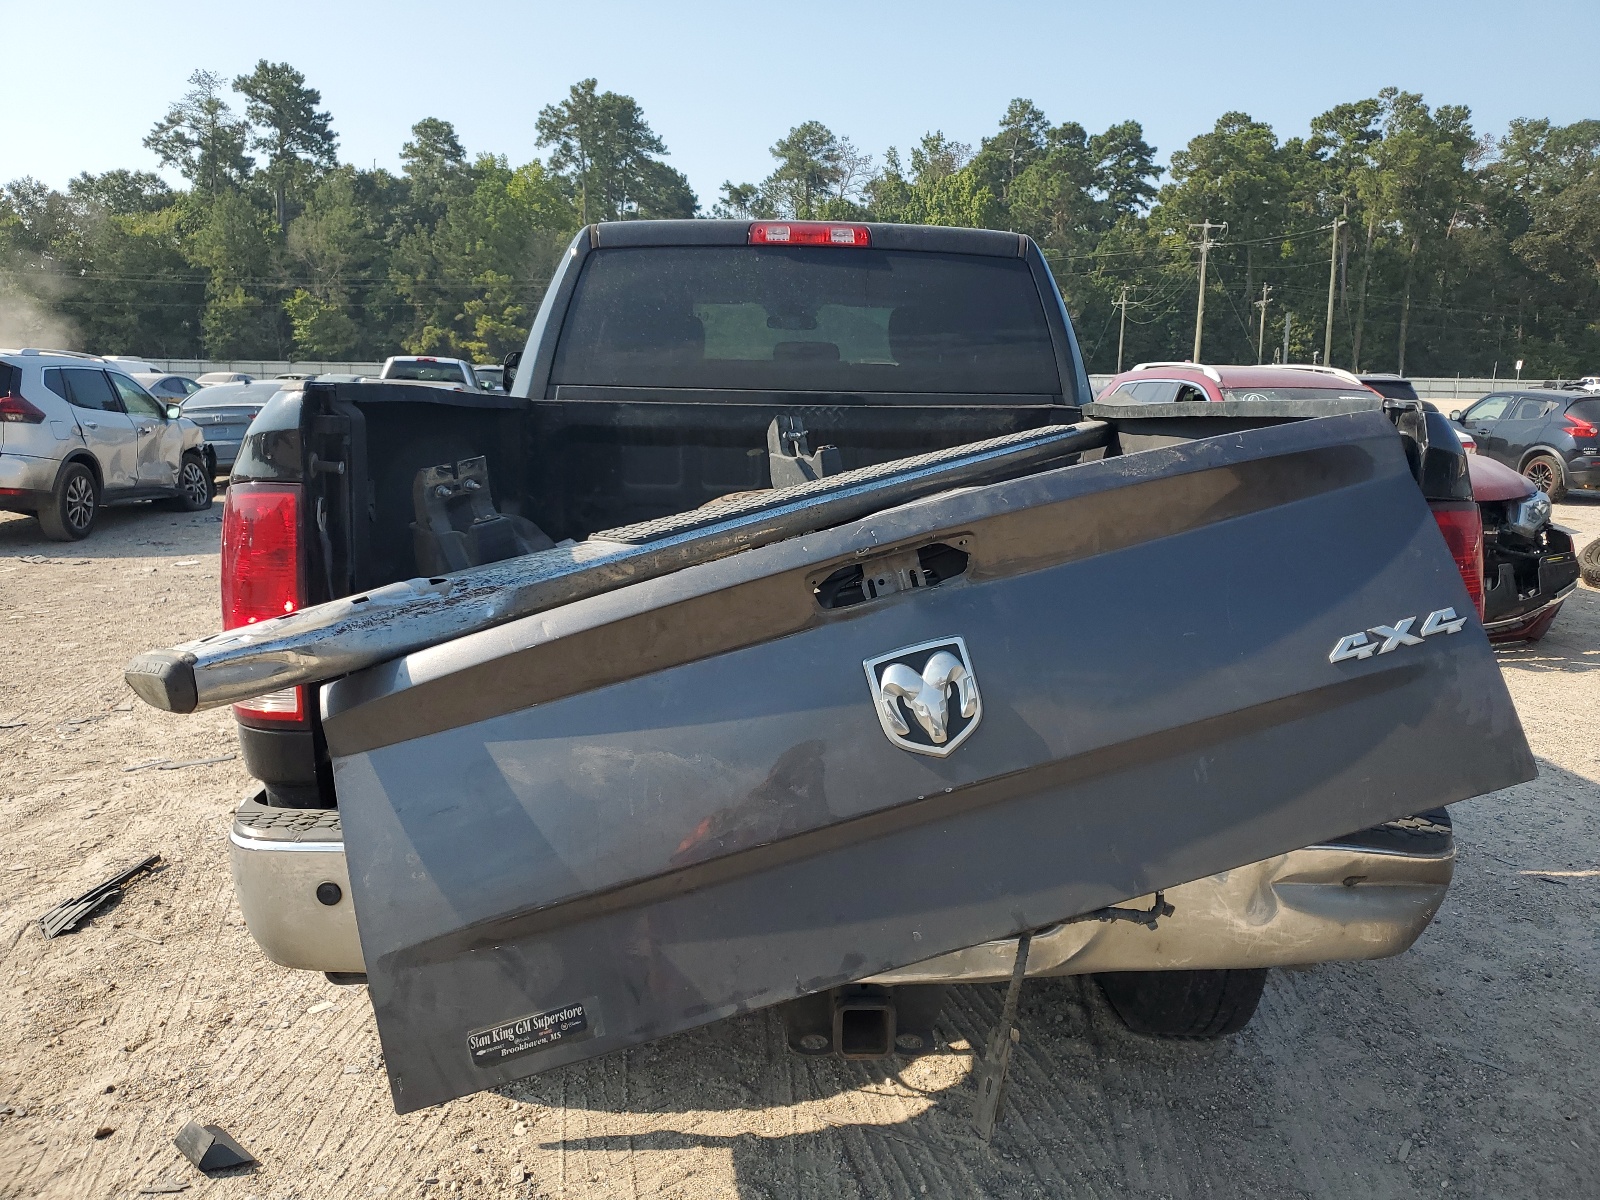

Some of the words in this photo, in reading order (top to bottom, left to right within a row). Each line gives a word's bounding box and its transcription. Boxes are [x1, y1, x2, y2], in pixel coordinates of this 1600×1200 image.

[470, 1035, 491, 1050] Stan
[492, 1027, 515, 1041] King
[515, 1021, 531, 1035] GM
[533, 1006, 582, 1030] Superstore
[501, 1038, 548, 1057] Brookhaven,
[550, 1031, 562, 1042] MS
